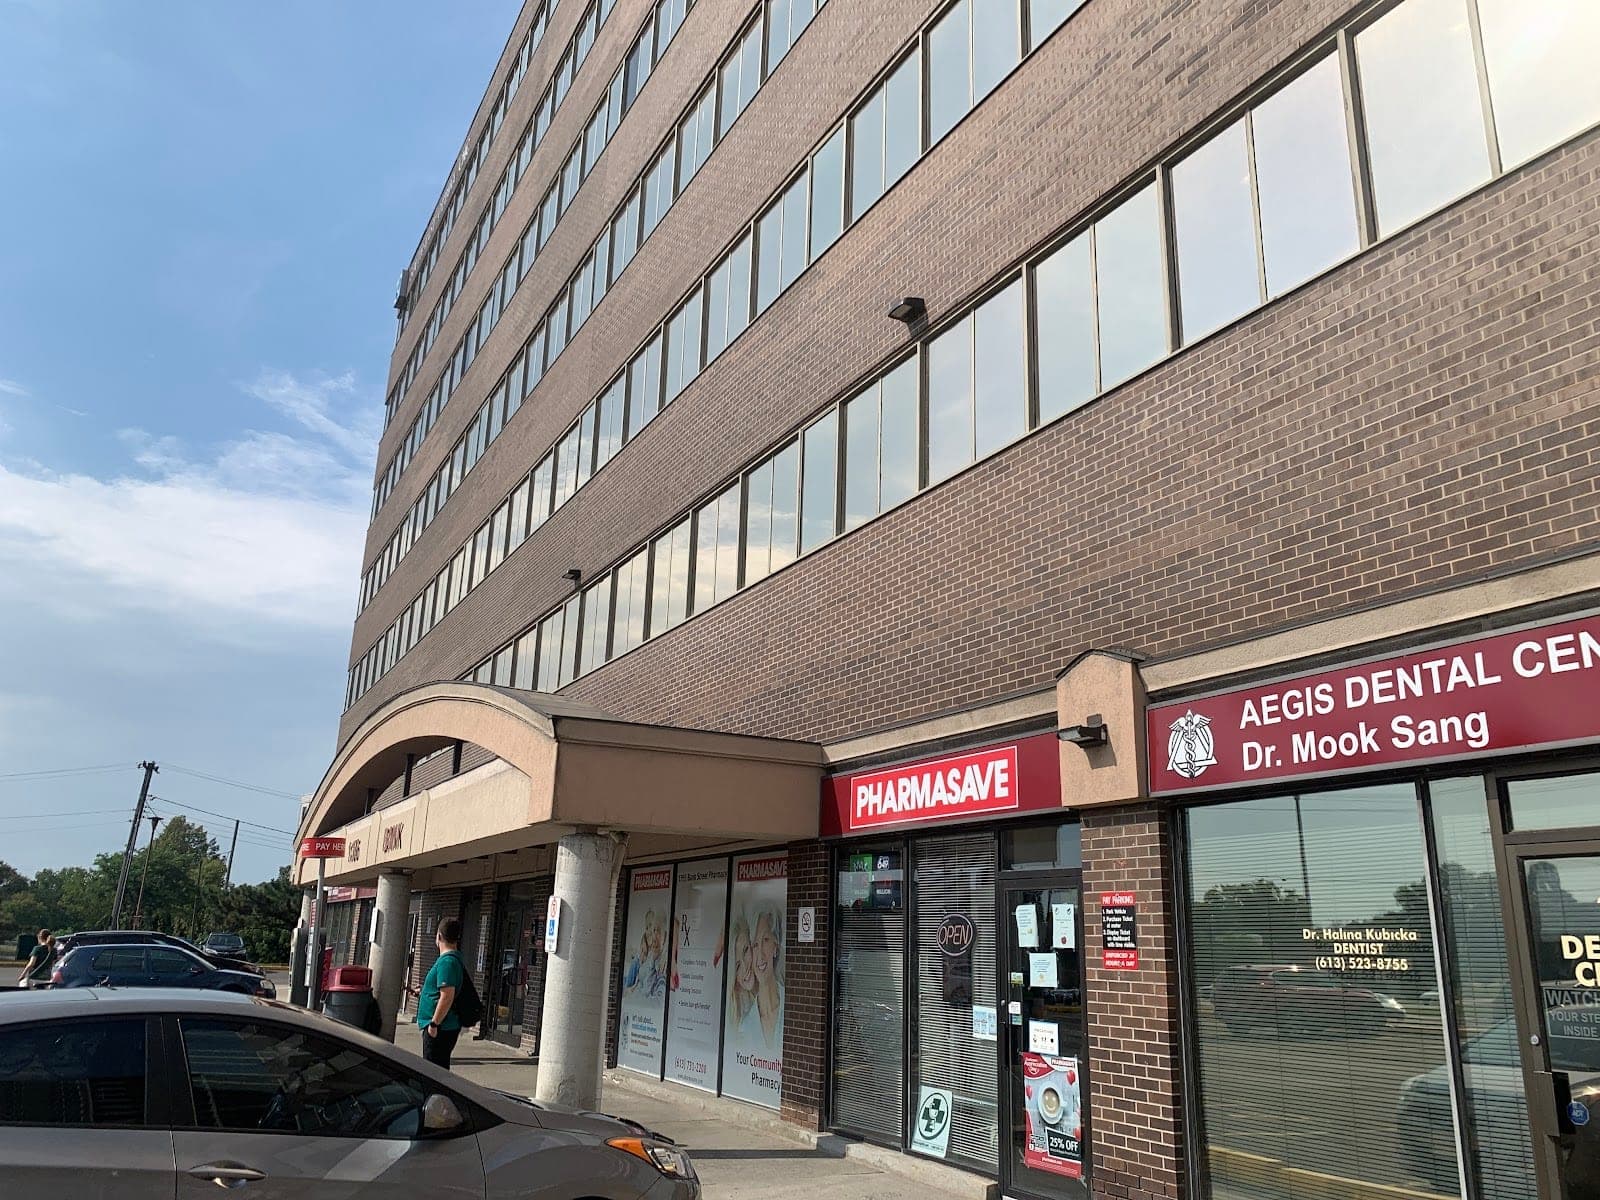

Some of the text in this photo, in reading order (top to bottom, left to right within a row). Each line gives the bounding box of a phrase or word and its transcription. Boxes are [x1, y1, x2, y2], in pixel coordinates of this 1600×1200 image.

[1239, 631, 1600, 729] AEGIS DENTAL CEN
[1242, 711, 1490, 771] Dr. Mook Sang
[856, 759, 1008, 818] PHARMASAVE
[315, 842, 331, 851] PAY
[739, 860, 787, 878] PHARMASAVE
[635, 872, 670, 889] PHARMASAVE
[939, 925, 969, 945] OPEN
[1302, 928, 1417, 940] Dr. Halina Kubicka
[1333, 943, 1384, 955] DENTIST
[1560, 935, 1600, 960] DE
[1315, 956, 1409, 971] (613) 523-8755
[1546, 990, 1600, 1008] WATCH
[1551, 1011, 1579, 1022] YOUR
[1563, 1025, 1599, 1038] INSIDE
[736, 1052, 783, 1076] Your Community
[752, 1072, 780, 1094] Pharmacy
[1050, 1137, 1065, 1149] 25%
[1065, 1140, 1079, 1152] OFF
